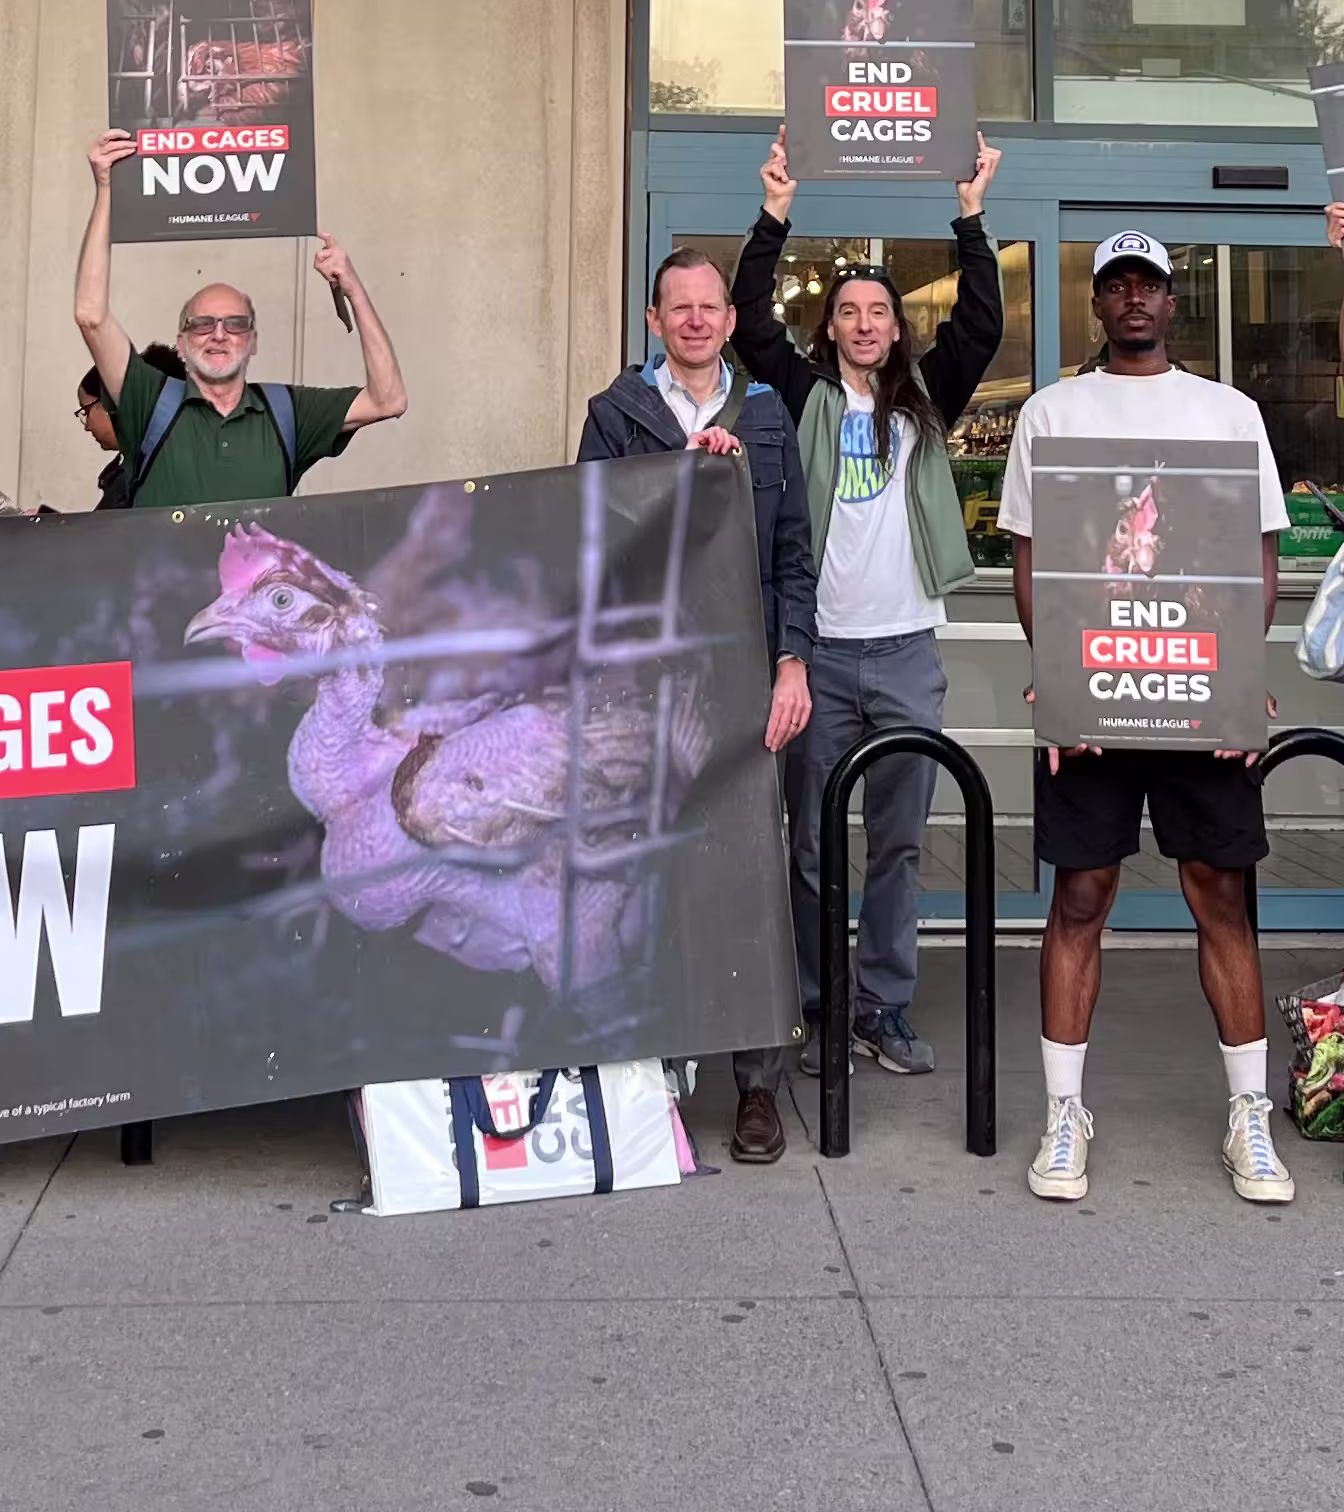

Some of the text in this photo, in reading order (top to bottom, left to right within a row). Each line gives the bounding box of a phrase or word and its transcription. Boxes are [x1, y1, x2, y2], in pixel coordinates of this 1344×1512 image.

[848, 62, 912, 84] END
[831, 90, 932, 113] CRUEL
[141, 129, 286, 151] END CAGES
[830, 119, 932, 142] CAGES
[842, 155, 914, 164] HUMANE LEAGUE
[142, 153, 286, 196] NOW
[172, 212, 251, 224] HUMANE LEAGUE
[1289, 526, 1332, 543] Sprite
[1110, 600, 1188, 628] END
[1089, 635, 1211, 665] CRUEL
[1088, 671, 1212, 702] CAGES
[1103, 717, 1190, 729] HUMANE LEAGUE
[12, 1104, 23, 1117] of
[25, 1105, 32, 1115] a
[33, 1098, 67, 1117] typical
[68, 1094, 104, 1110] factory
[106, 1091, 131, 1104] farm
